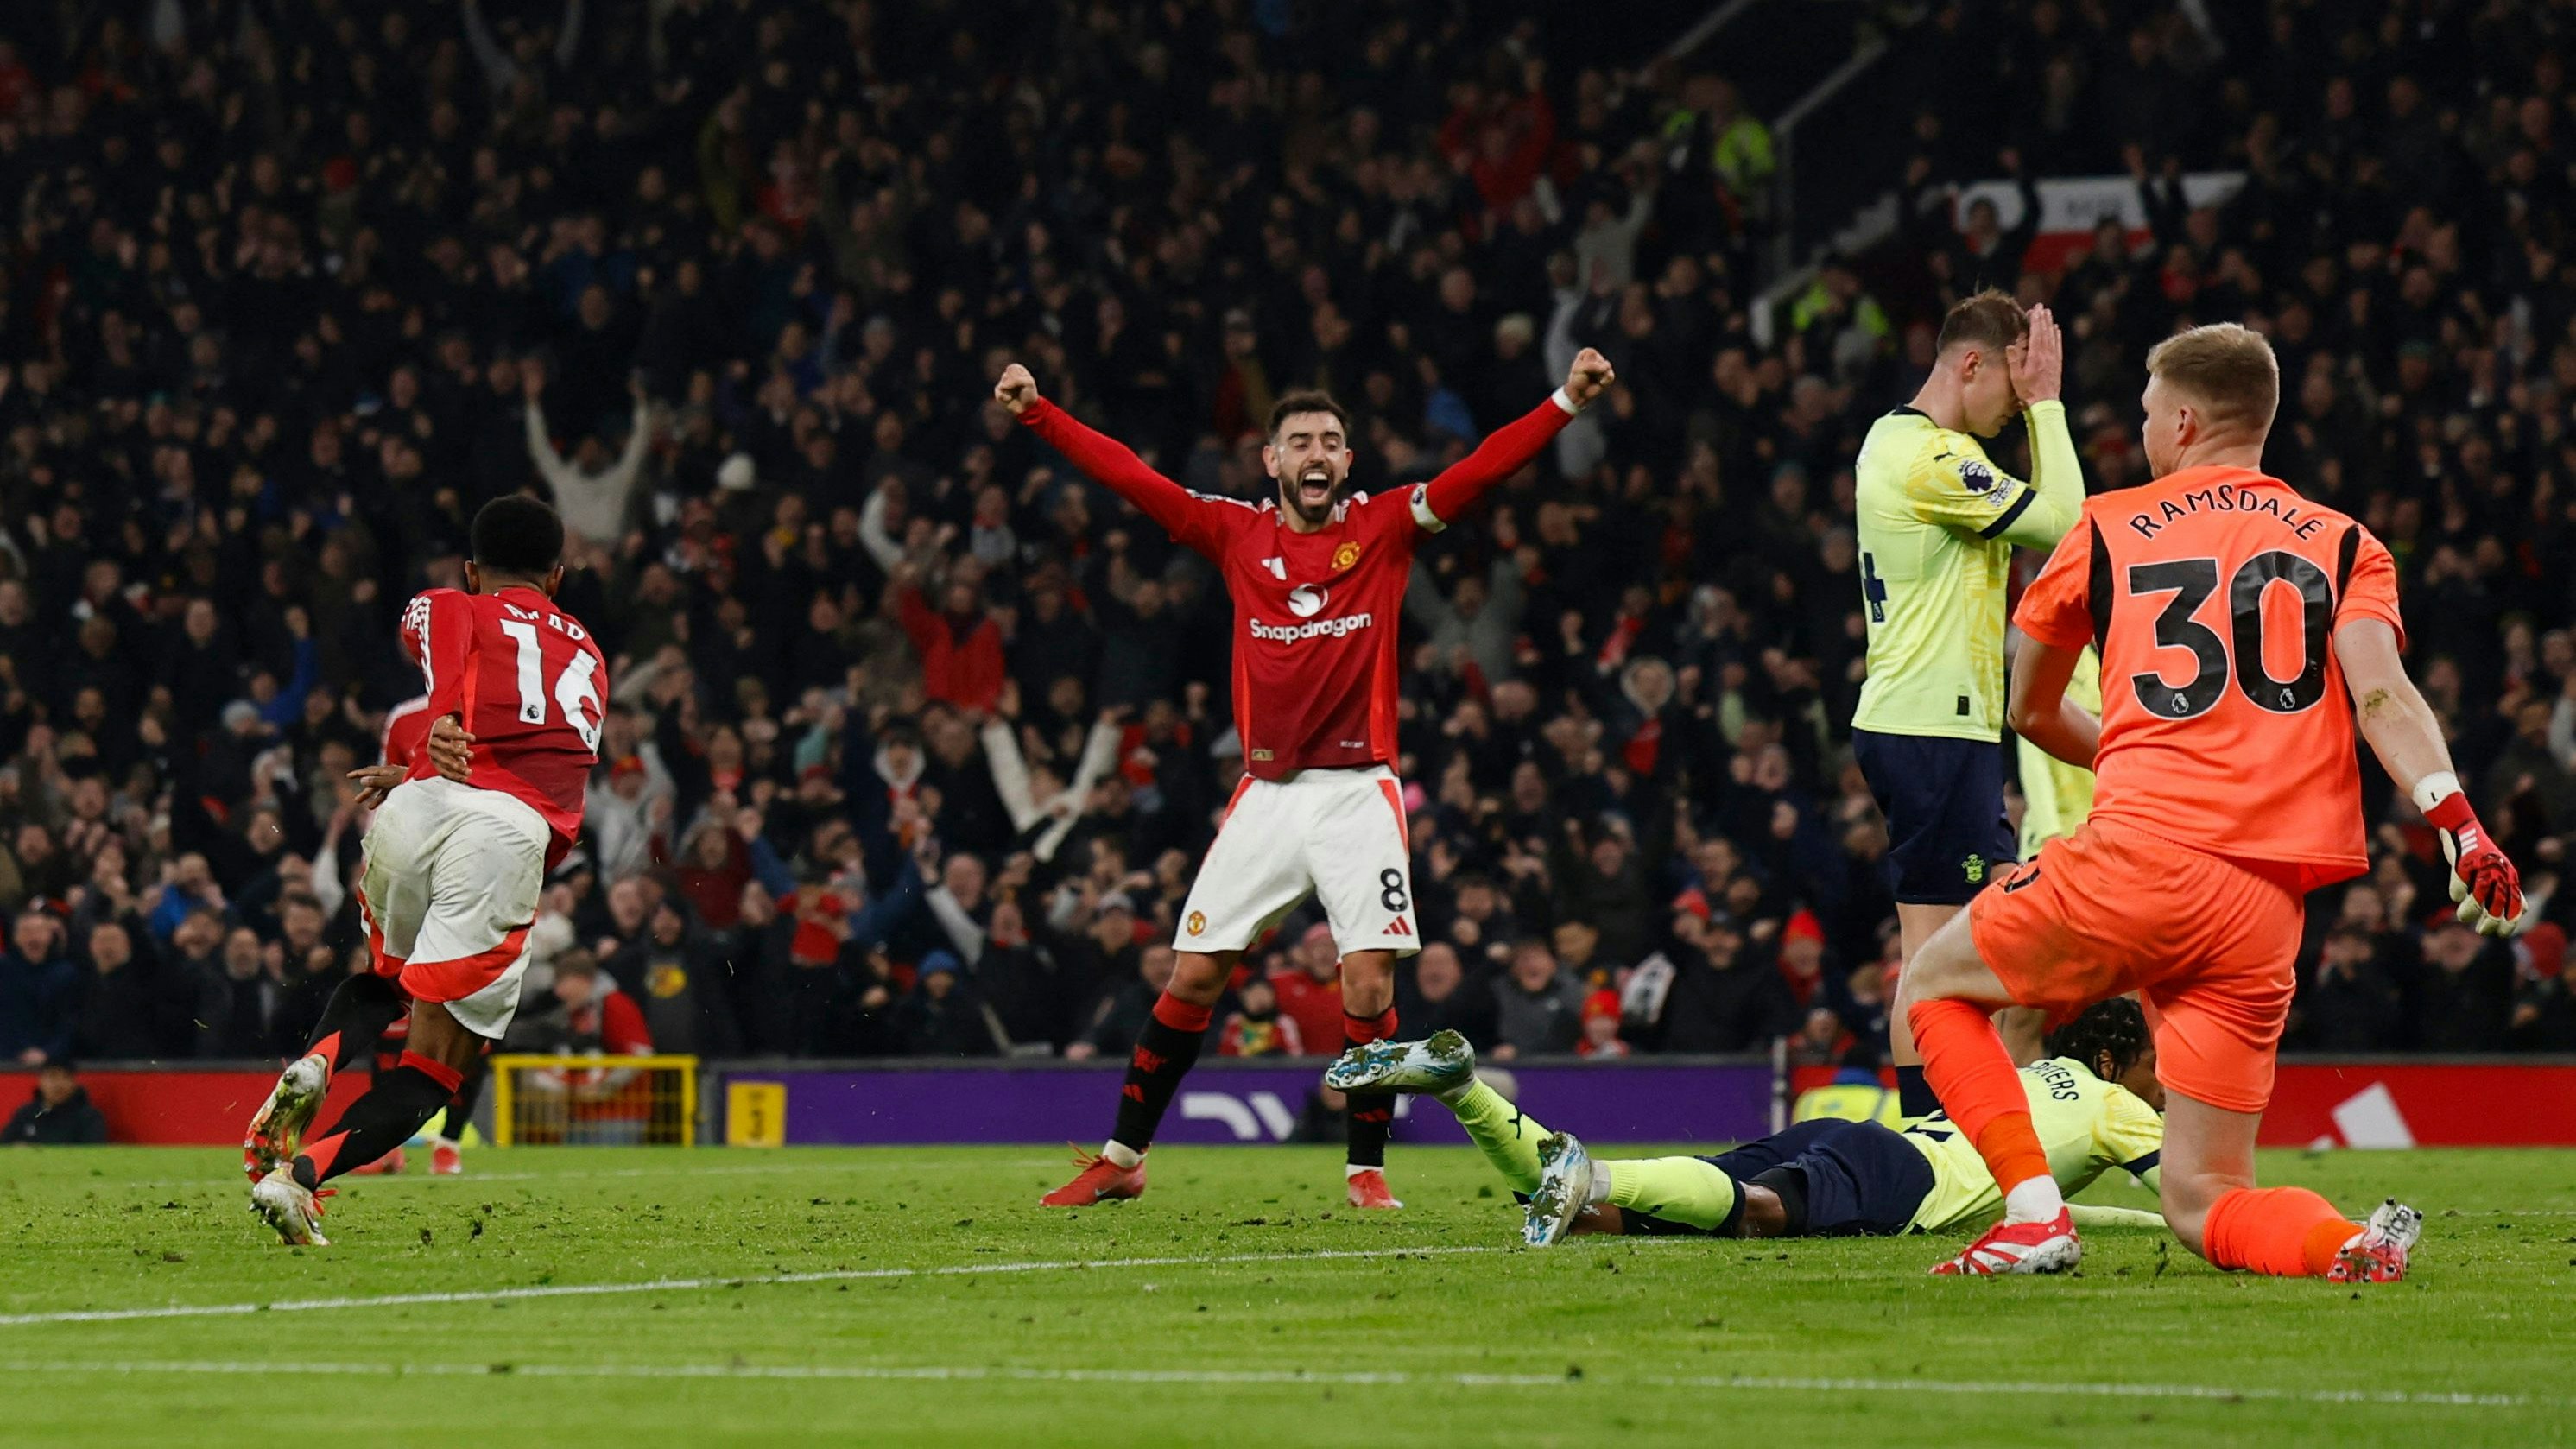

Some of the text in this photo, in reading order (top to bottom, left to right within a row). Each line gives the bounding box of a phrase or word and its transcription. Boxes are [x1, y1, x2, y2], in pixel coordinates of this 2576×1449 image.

[2128, 484, 2325, 541] RAMSDALE
[1249, 612, 1372, 645] Snapdragon
[2127, 550, 2336, 720] 30
[498, 617, 604, 756] 16
[1380, 868, 1408, 912] 8
